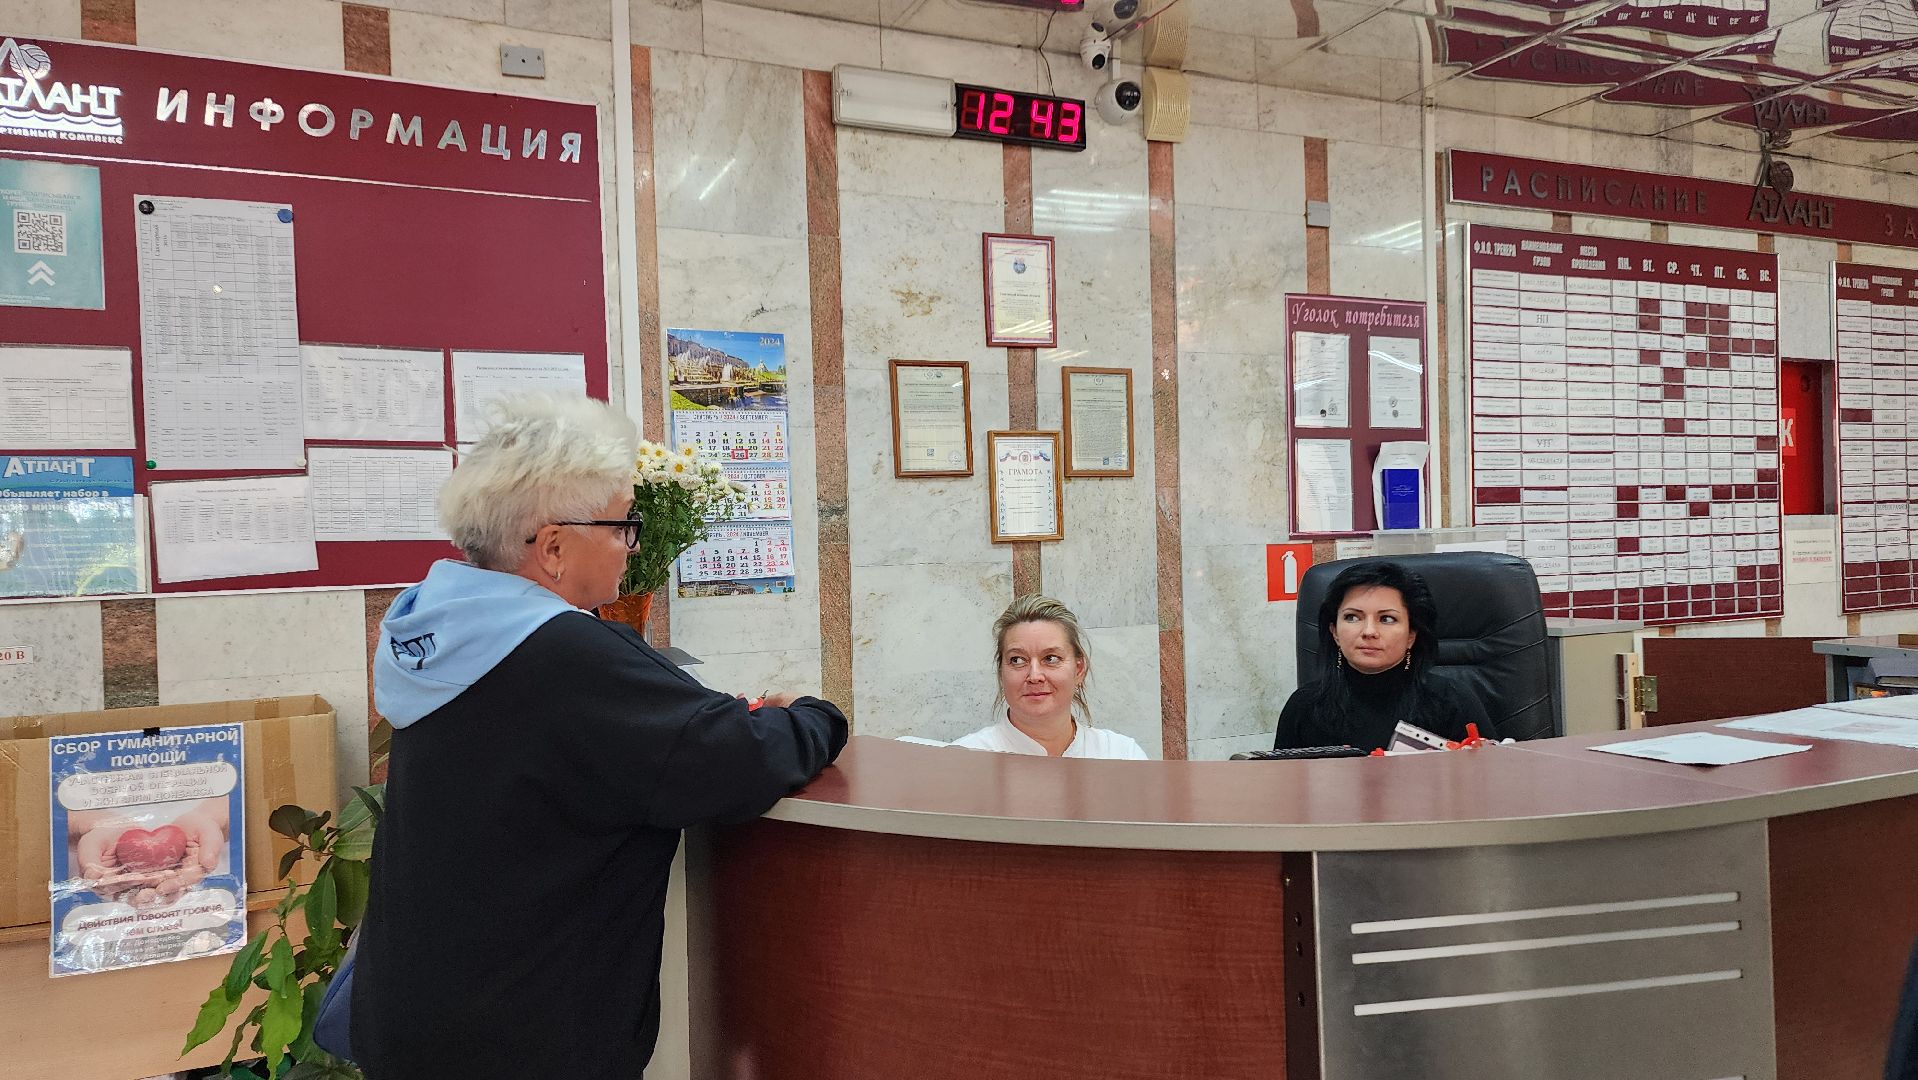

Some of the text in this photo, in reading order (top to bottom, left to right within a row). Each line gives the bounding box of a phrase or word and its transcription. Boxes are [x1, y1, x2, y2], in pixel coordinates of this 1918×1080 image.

[0, 77, 122, 116] ТЛАНТ
[156, 87, 582, 163] ИНФОРМАЦИЯ
[976, 91, 1081, 143] 12 43
[1481, 165, 1707, 214] РАСПИСАНИЕ
[1667, 261, 1679, 275] СР.
[1690, 264, 1702, 277] ЧТ.
[1714, 266, 1726, 279] ПТ.
[1737, 268, 1749, 281] СБ.
[1760, 269, 1772, 282] ВС.
[1292, 302, 1420, 331] Уголок потребителя
[760, 336, 780, 347] 2024
[1008, 468, 1043, 476] ГРАМОТА
[63, 489, 101, 498] набор
[53, 727, 239, 756] СБОР ГУМАНИТАРНОЙ
[111, 750, 187, 767] ПОМОЩИ
